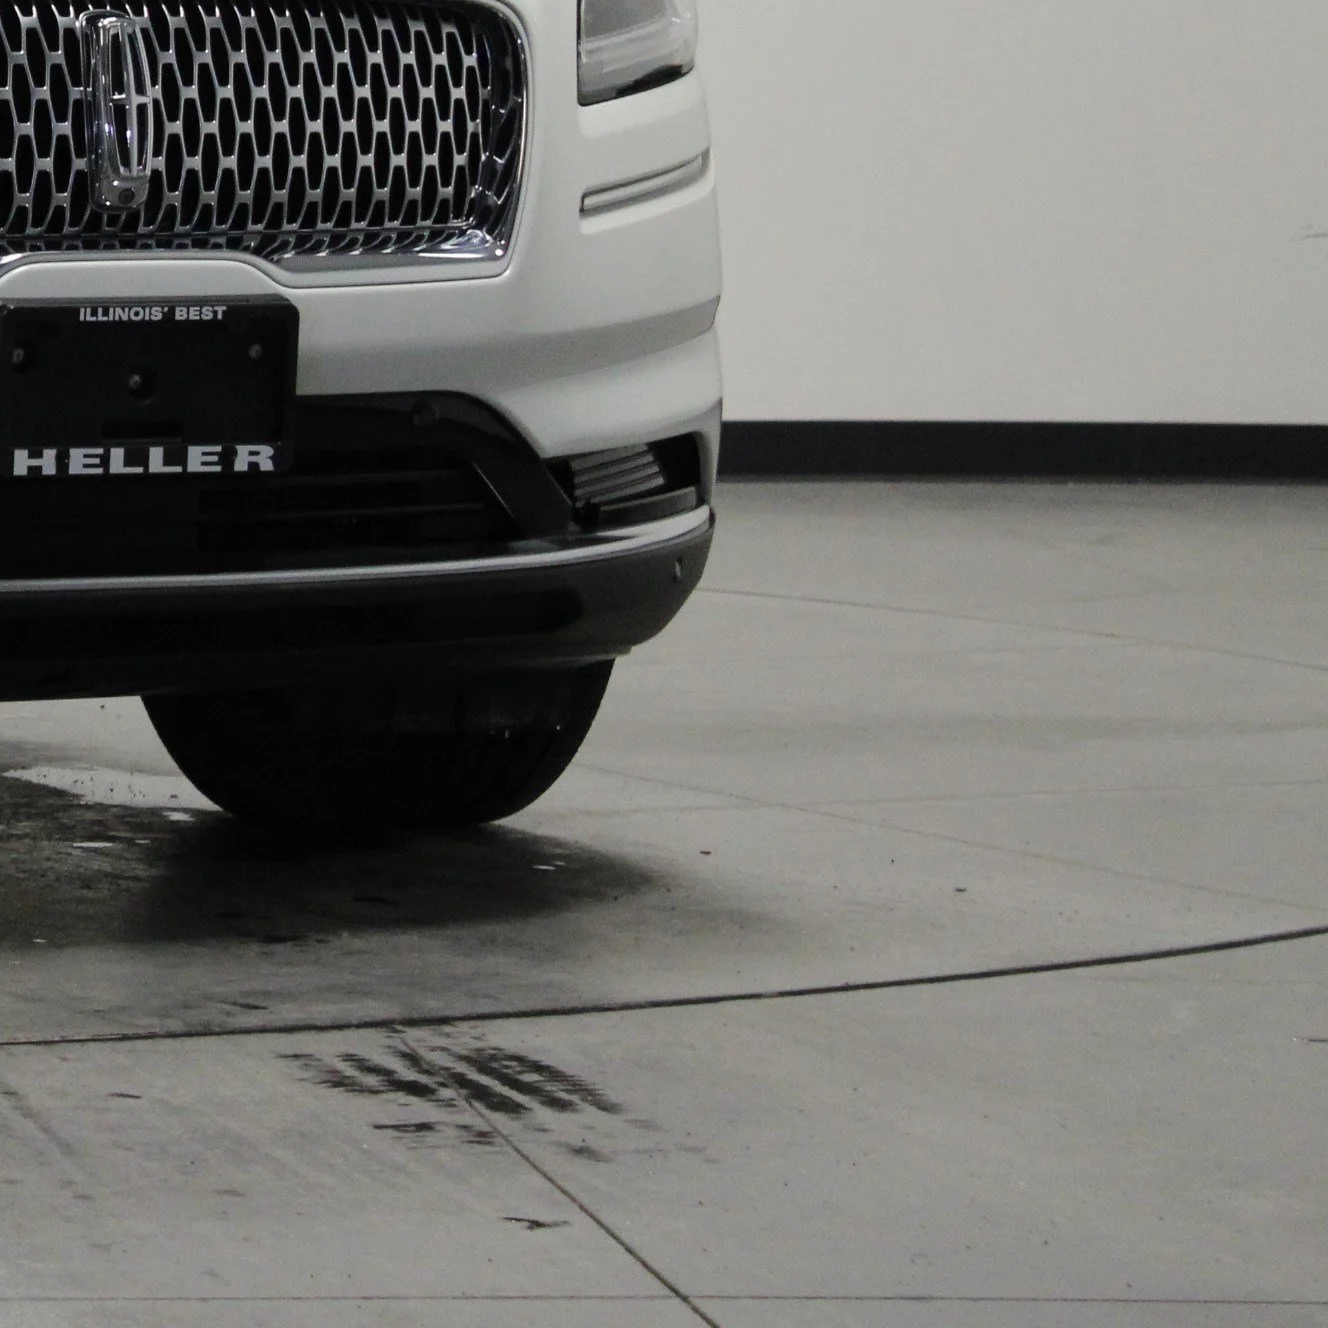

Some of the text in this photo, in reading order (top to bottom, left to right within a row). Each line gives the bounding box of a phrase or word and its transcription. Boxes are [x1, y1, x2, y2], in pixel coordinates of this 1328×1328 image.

[79, 306, 227, 321] ILLINOIS' BEST
[13, 445, 275, 476] HELLER
